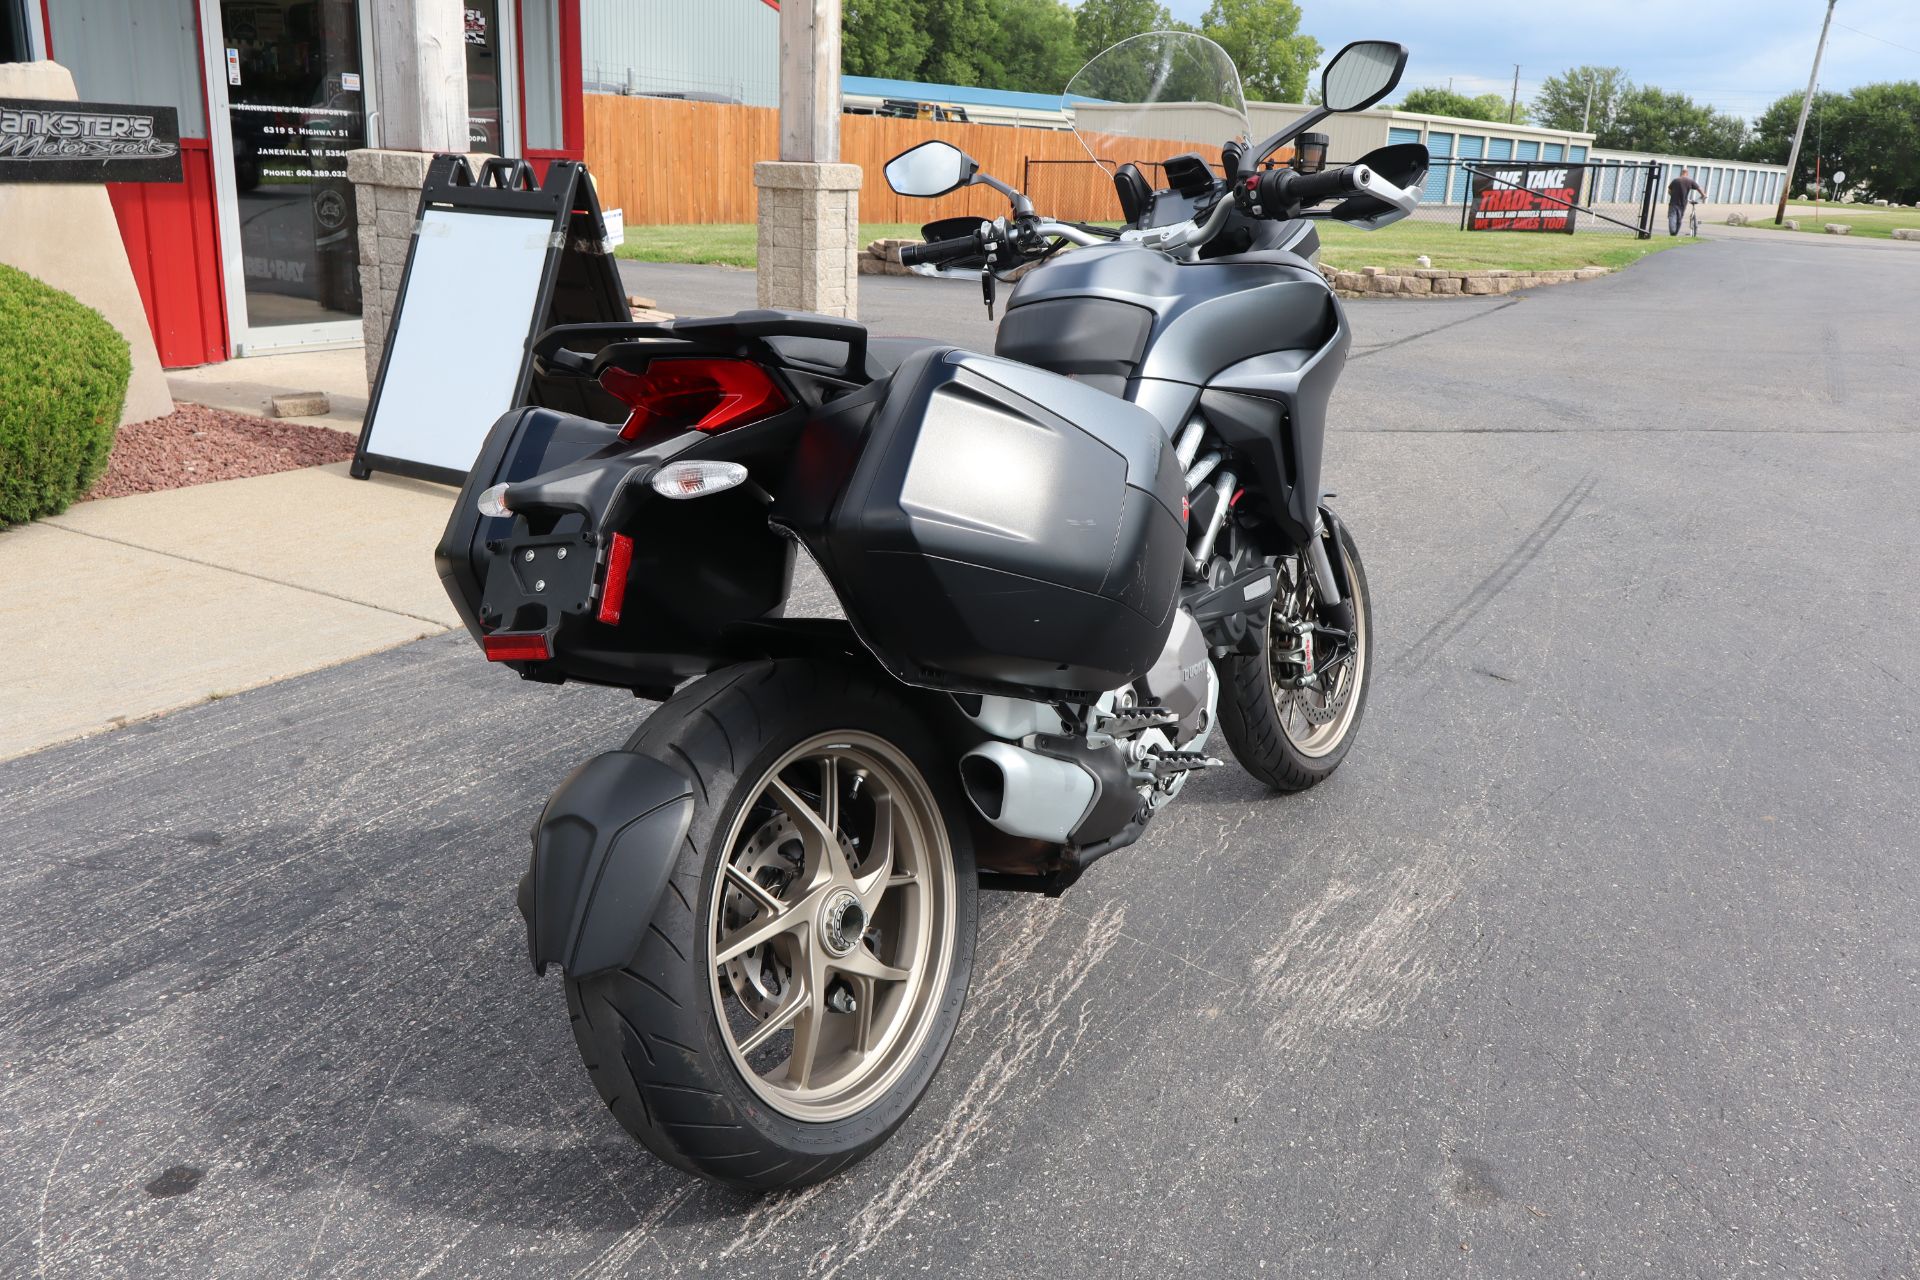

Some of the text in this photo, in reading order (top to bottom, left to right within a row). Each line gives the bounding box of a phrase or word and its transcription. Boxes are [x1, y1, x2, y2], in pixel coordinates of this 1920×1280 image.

[292, 106, 348, 117] MOTORSPORTS
[263, 126, 286, 135] 6319
[288, 127, 297, 136] S.
[300, 128, 337, 137] HIGHWAY
[257, 147, 310, 157] JANESVILLE,
[311, 149, 323, 157] WI
[263, 168, 347, 178] PHONE: 608.289.032
[1492, 170, 1568, 190] WE TAKE
[1479, 188, 1575, 210] TRADE-INS
[1540, 210, 1569, 218] WELCOME
[1543, 217, 1568, 229] TOO!
